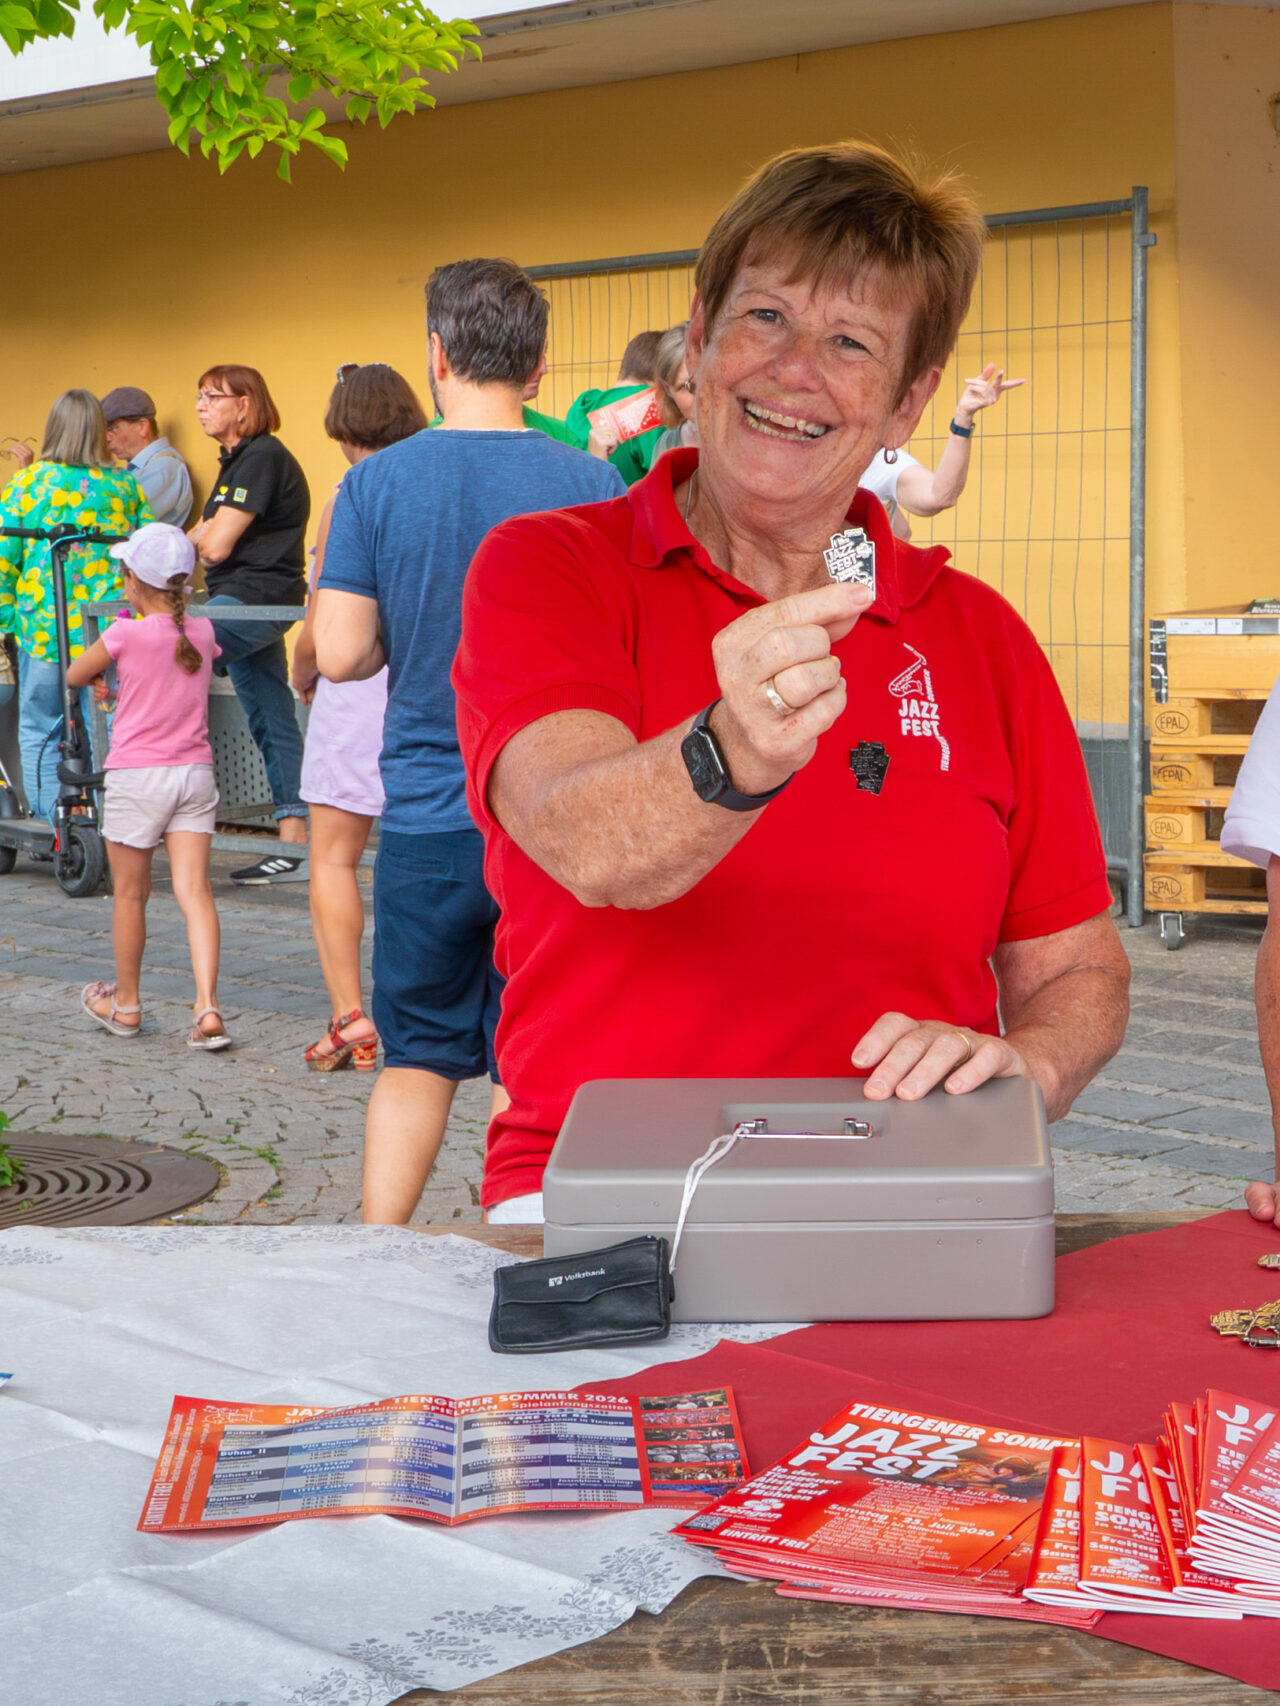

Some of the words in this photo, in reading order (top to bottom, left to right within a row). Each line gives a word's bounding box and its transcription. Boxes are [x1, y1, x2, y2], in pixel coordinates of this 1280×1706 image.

[899, 698, 940, 719] JAZZ
[901, 718, 940, 738] FEST
[1159, 715, 1185, 730] EPAL
[1154, 821, 1179, 834] EPAL
[1151, 880, 1179, 895] EPAL
[564, 1268, 607, 1282] Volksbank
[393, 1396, 493, 1409] TIENGENER
[499, 1392, 580, 1403] SOMMER
[584, 1394, 629, 1404] 2026
[422, 1404, 498, 1417] SPIELPLAN
[511, 1401, 633, 1411] Spielanfangszeiten
[849, 1403, 987, 1440] TIENGENER
[809, 1423, 978, 1460] JAZZ
[787, 1446, 958, 1480] FEST
[764, 1471, 843, 1485] Tiengener
[791, 1469, 820, 1477] der
[745, 1481, 794, 1493] Musik
[797, 1488, 829, 1496] auf
[754, 1476, 820, 1488] Altstadt
[873, 1477, 922, 1488] Freitag
[962, 1489, 989, 1497] Juli
[991, 1494, 1028, 1503] 2026
[751, 1490, 813, 1501] Bühnen
[715, 1505, 783, 1520] Tiengen
[828, 1503, 890, 1520] Samstag
[902, 1517, 923, 1526] 25.
[927, 1521, 954, 1531] Juli
[958, 1526, 996, 1537] 2026
[719, 1529, 779, 1544] EINTRITT
[779, 1538, 812, 1550] FREI
[1101, 1536, 1159, 1554] Freitag
[1089, 1541, 1160, 1561] Samstag
[1089, 1565, 1162, 1582] Tiengen
[830, 1587, 891, 1599] EINTRITT
